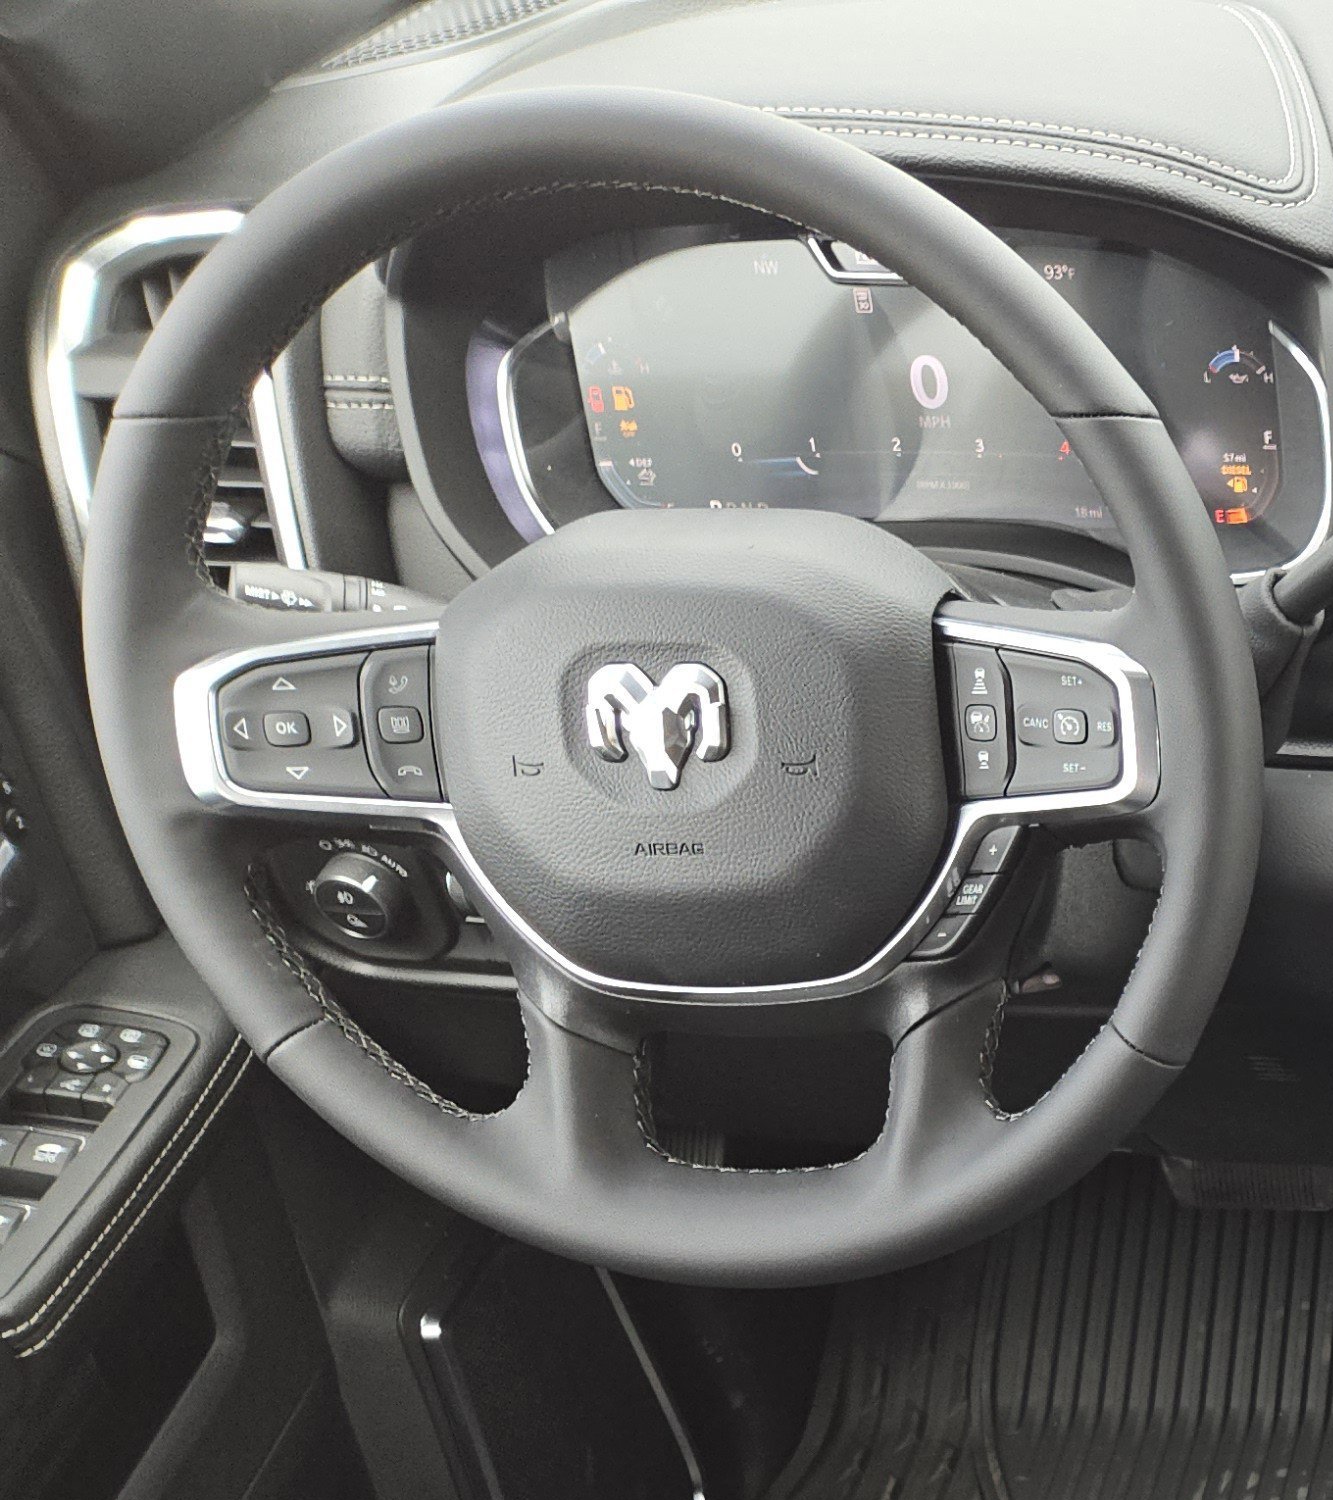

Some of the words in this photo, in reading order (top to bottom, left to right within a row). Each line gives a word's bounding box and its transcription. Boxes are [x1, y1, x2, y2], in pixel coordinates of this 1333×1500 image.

[753, 260, 779, 275] NW
[909, 354, 949, 410] 0
[918, 415, 950, 429] MPH
[731, 442, 742, 457] 0
[808, 436, 817, 452] 1
[891, 436, 902, 452] 2
[974, 438, 985, 453] 3
[1058, 439, 1071, 455] 4
[275, 721, 299, 735] OK
[1023, 717, 1049, 730] CANC
[1097, 721, 1112, 732] RES
[634, 842, 705, 856] AIRBAG
[962, 884, 984, 895] GEAR
